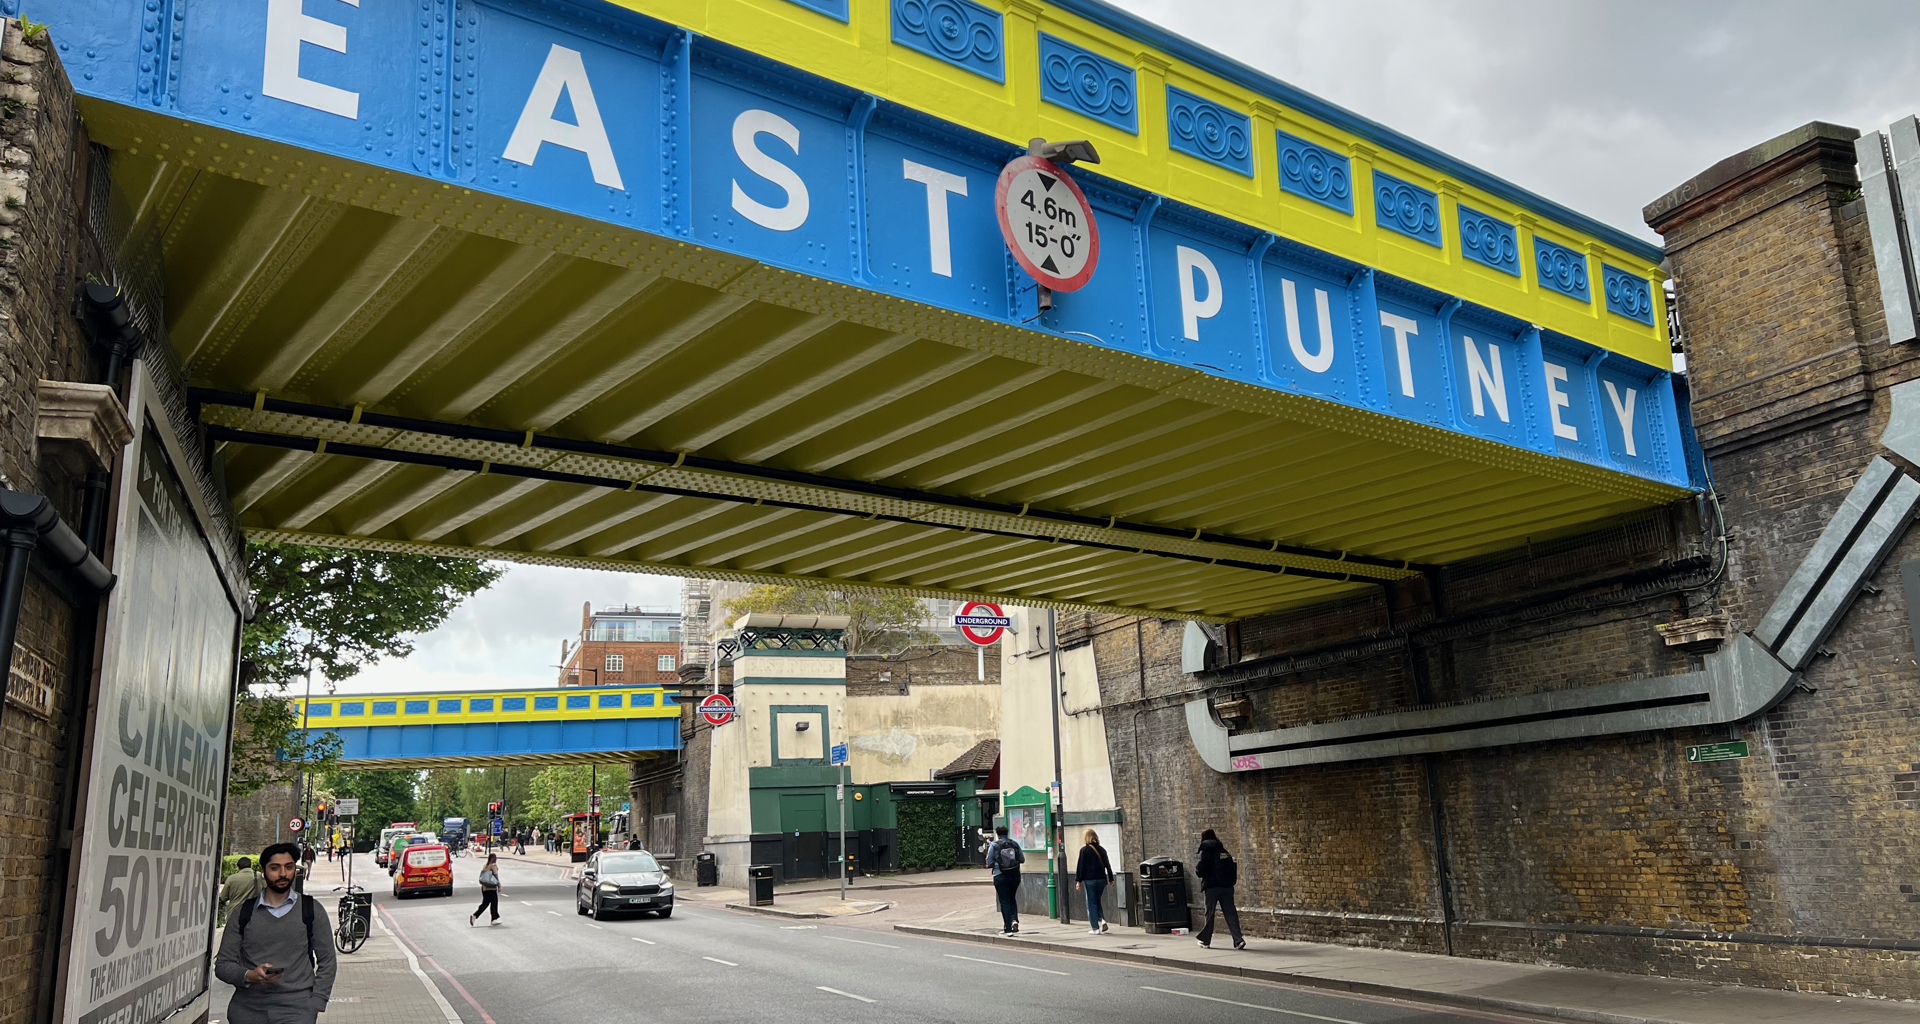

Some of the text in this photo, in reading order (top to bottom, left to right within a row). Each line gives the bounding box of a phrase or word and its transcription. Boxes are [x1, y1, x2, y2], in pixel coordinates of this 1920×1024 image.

[263, 0, 1636, 456] EAST PUTNEY
[1020, 189, 1077, 229] 4.6m
[152, 471, 169, 524] FOR
[957, 617, 1008, 625] UNDERGROUND
[747, 658, 845, 674] EAST PUTNEY
[118, 687, 218, 801] CINEMA
[108, 764, 216, 857] CELEBRATES
[95, 855, 210, 958] 50 YEARS
[89, 963, 107, 1004] THE
[106, 955, 131, 995] PARTY
[130, 946, 154, 984] STARTS
[134, 979, 174, 1023] CINEMA
[174, 966, 198, 1003] ALIVE
